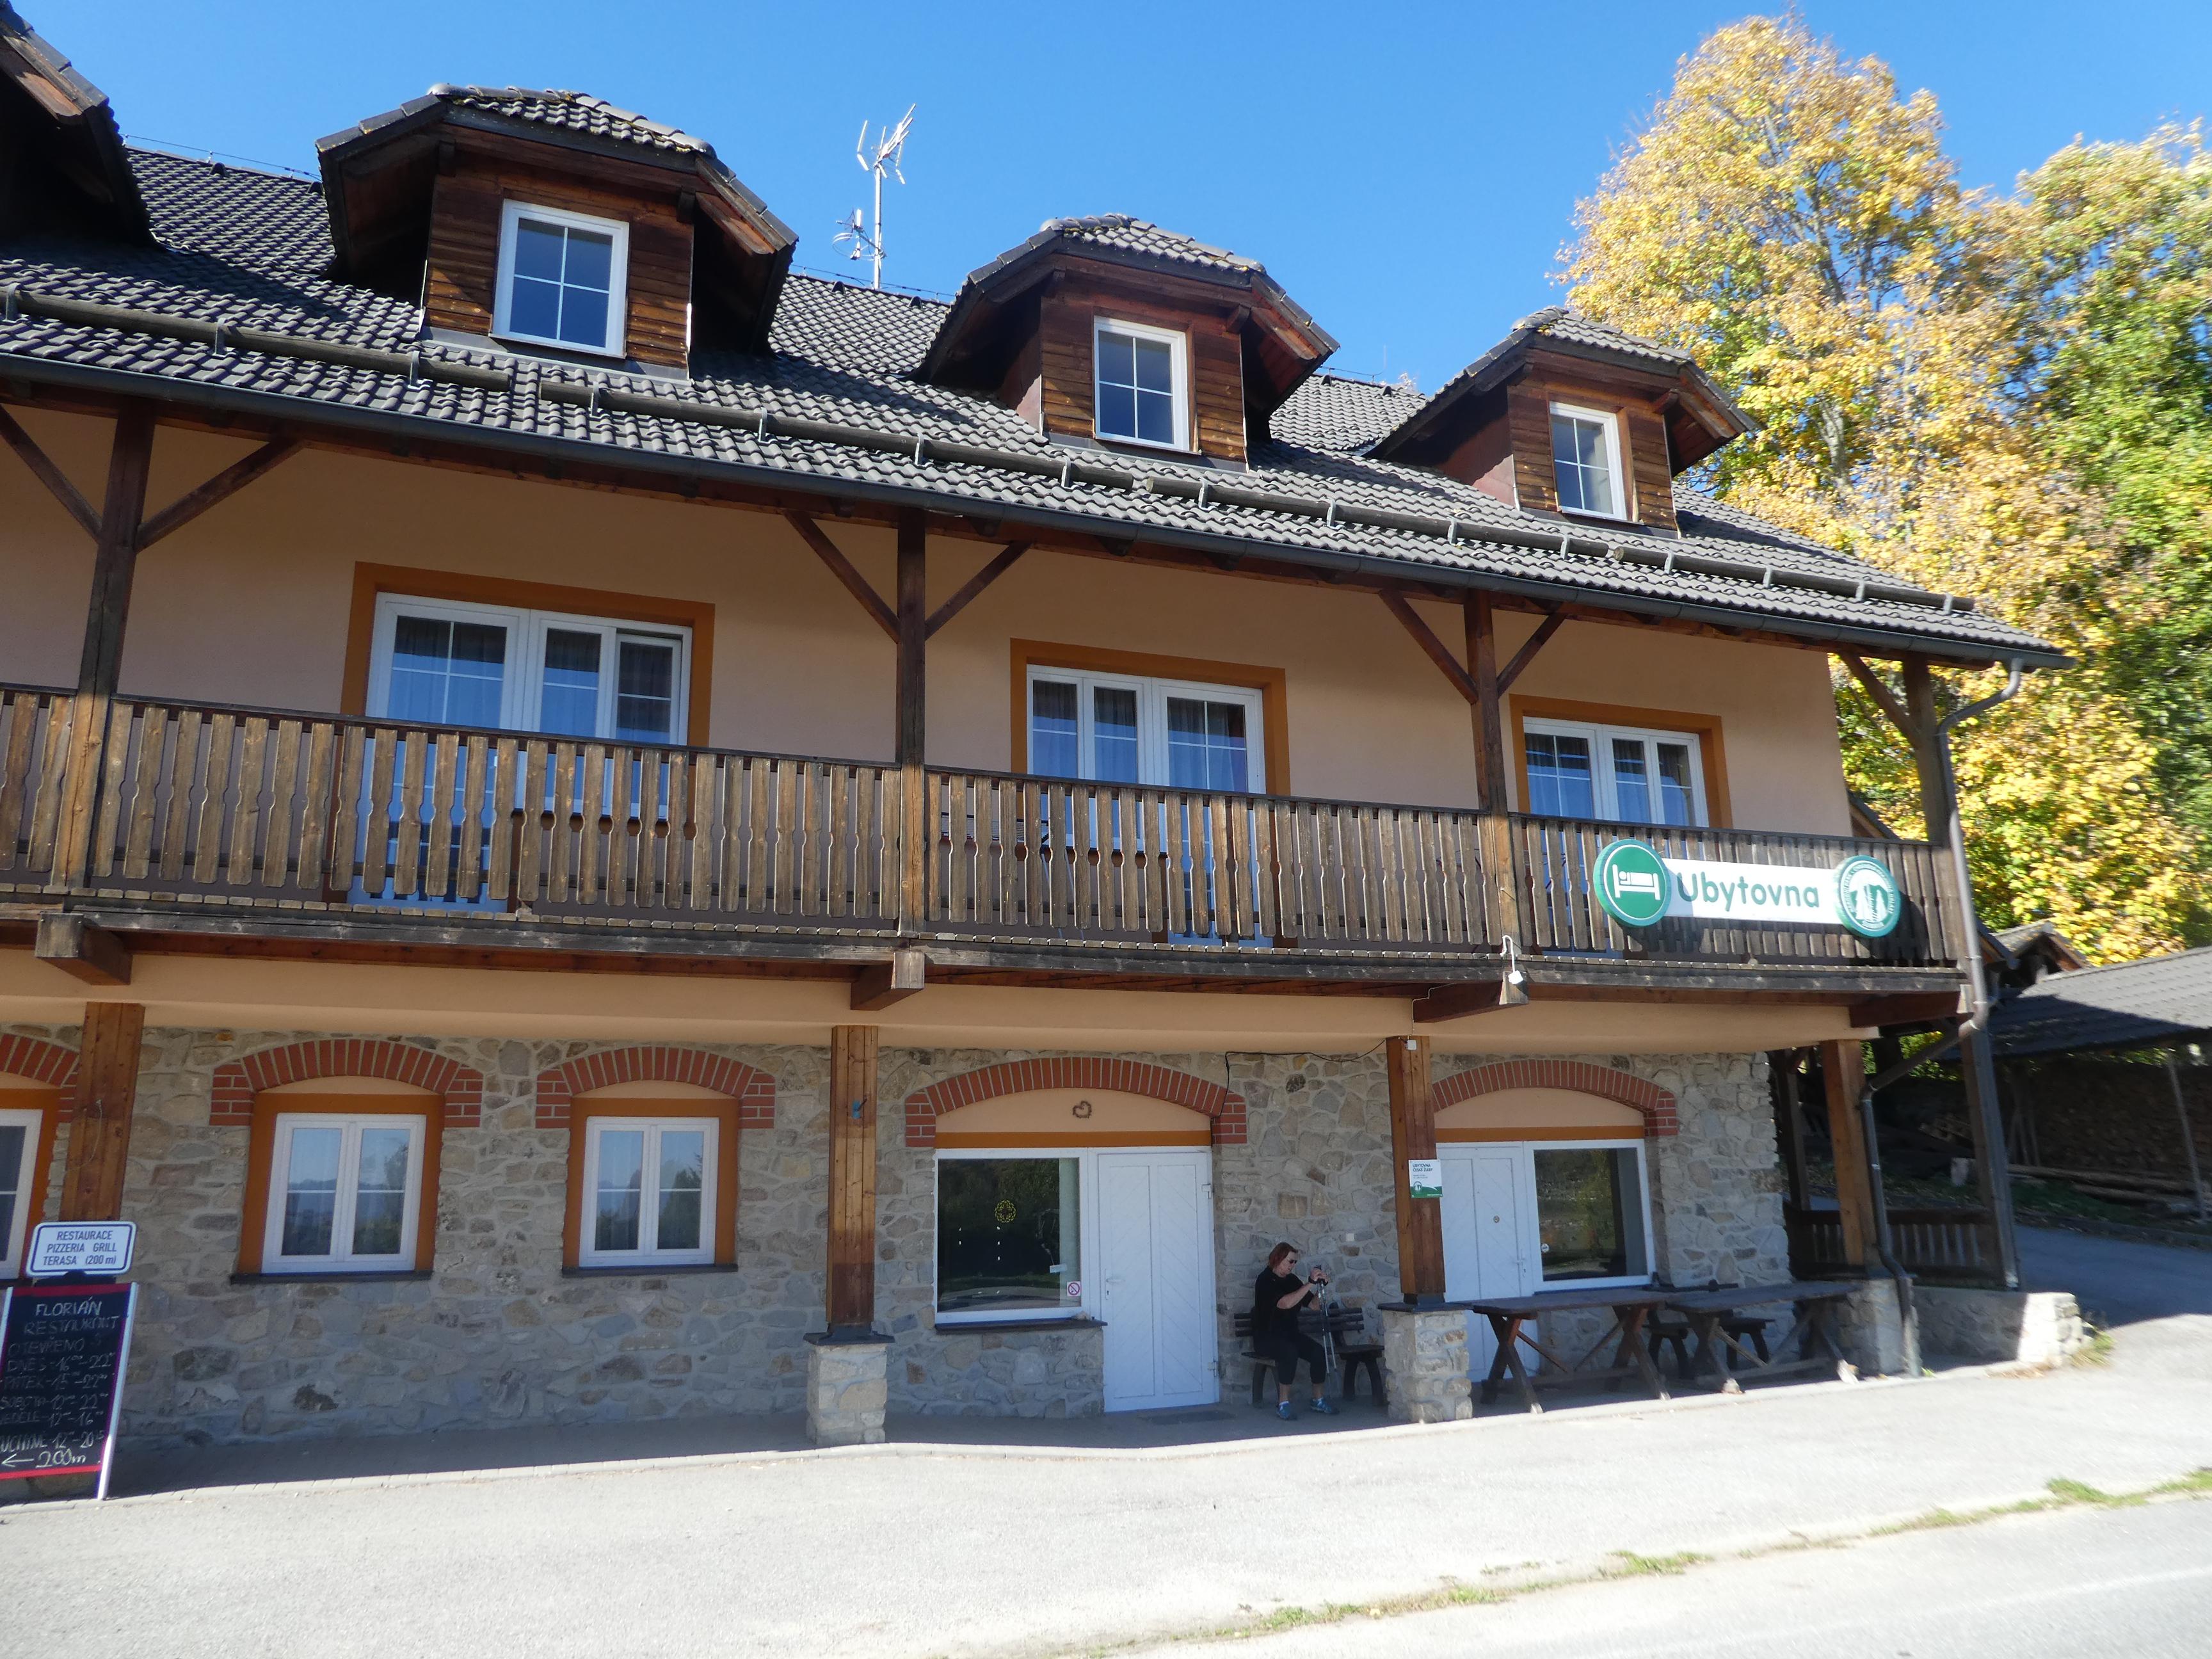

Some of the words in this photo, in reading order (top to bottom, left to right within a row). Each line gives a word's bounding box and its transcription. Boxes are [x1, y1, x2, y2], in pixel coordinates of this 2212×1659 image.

[1676, 871, 1820, 912] Ubytovna
[56, 1230, 113, 1241] RESTAURACE
[46, 1243, 84, 1253] PIZZERIA
[93, 1242, 116, 1252] GRILL
[43, 1256, 77, 1265] TERASA
[35, 1296, 102, 1317] FLORIÁN
